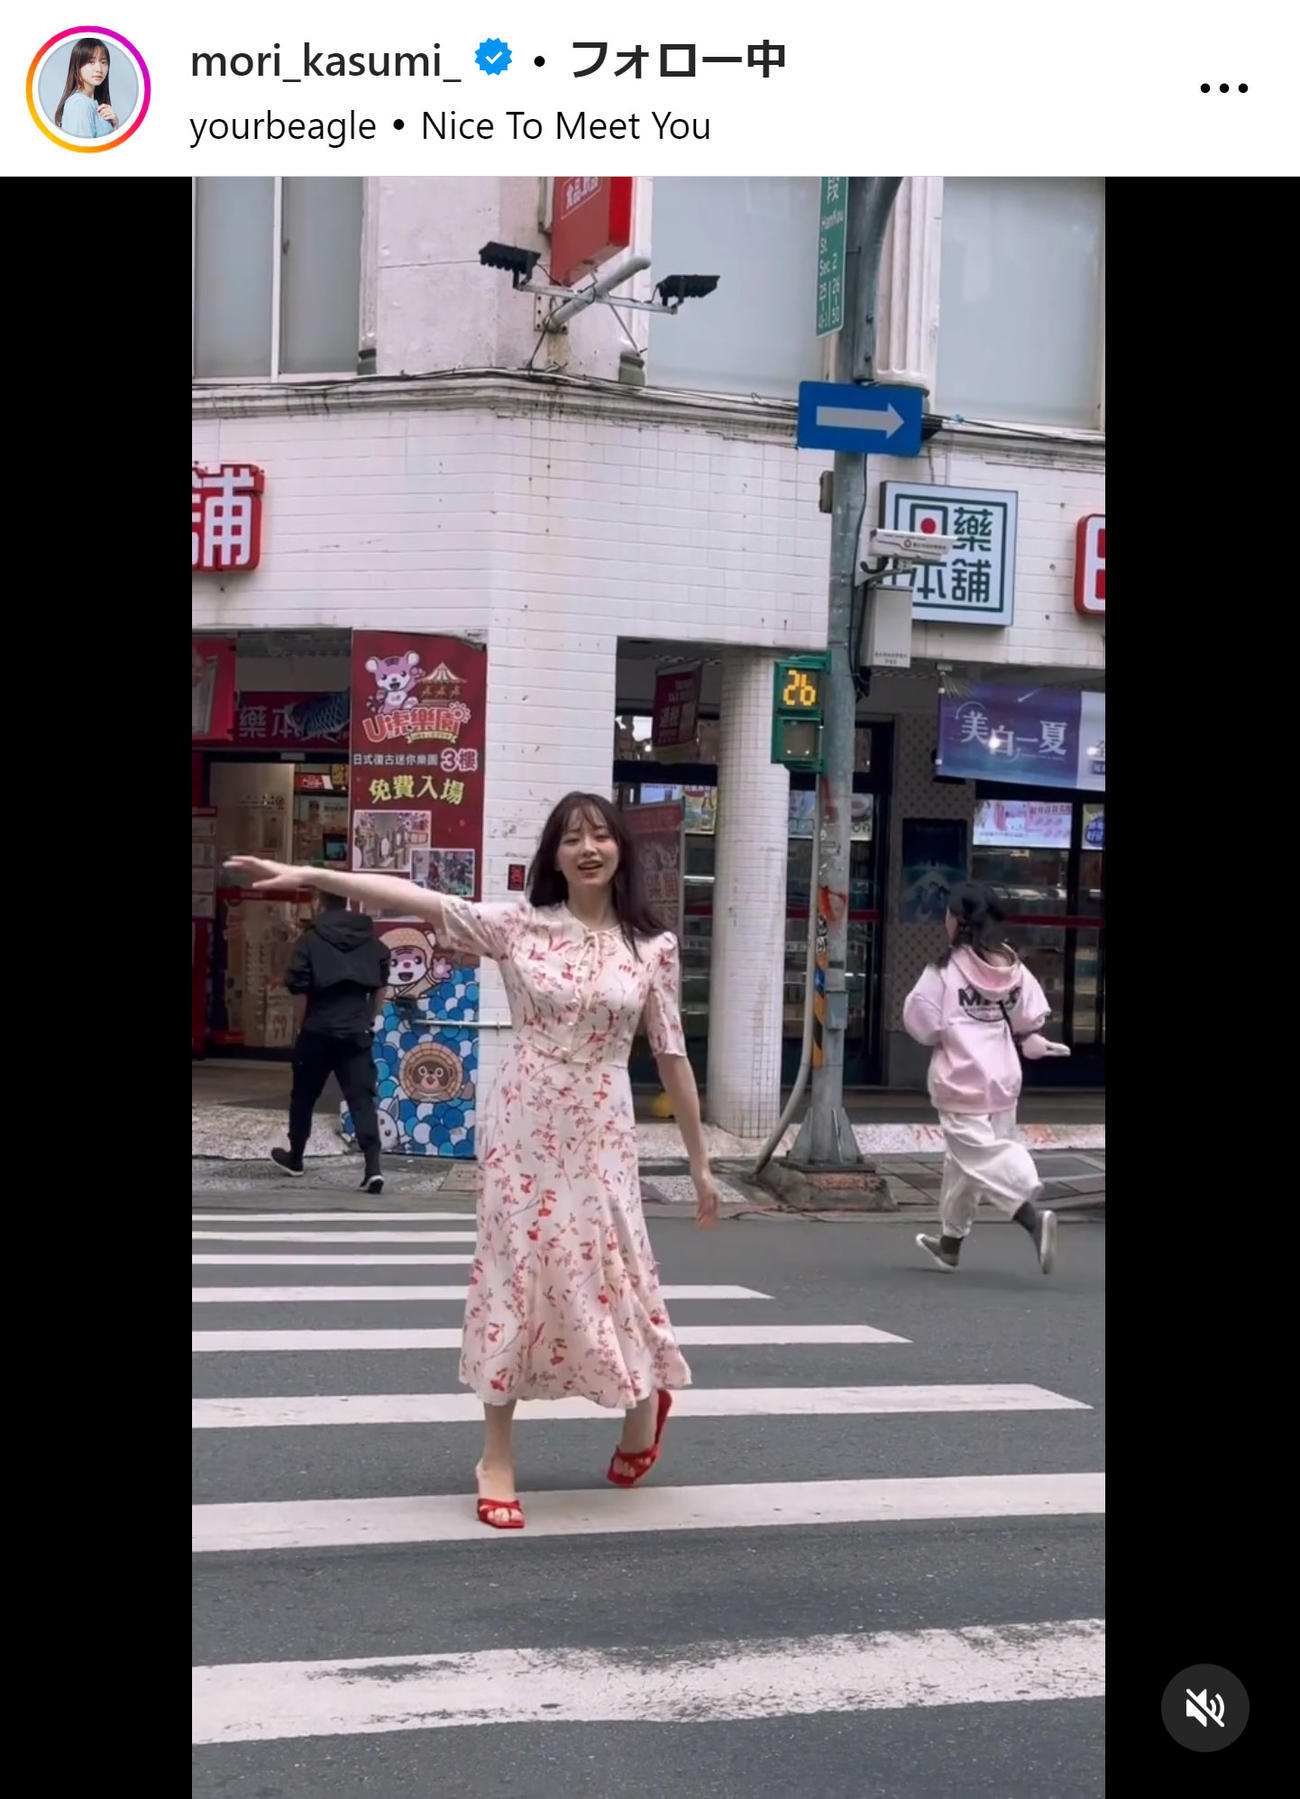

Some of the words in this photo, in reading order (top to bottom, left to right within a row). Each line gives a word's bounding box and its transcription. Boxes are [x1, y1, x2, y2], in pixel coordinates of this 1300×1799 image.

[783, 669, 816, 706] 26
[960, 710, 1068, 756] 美白一夏
[441, 748, 478, 772] 3樓
[369, 775, 465, 805] 免費入場
